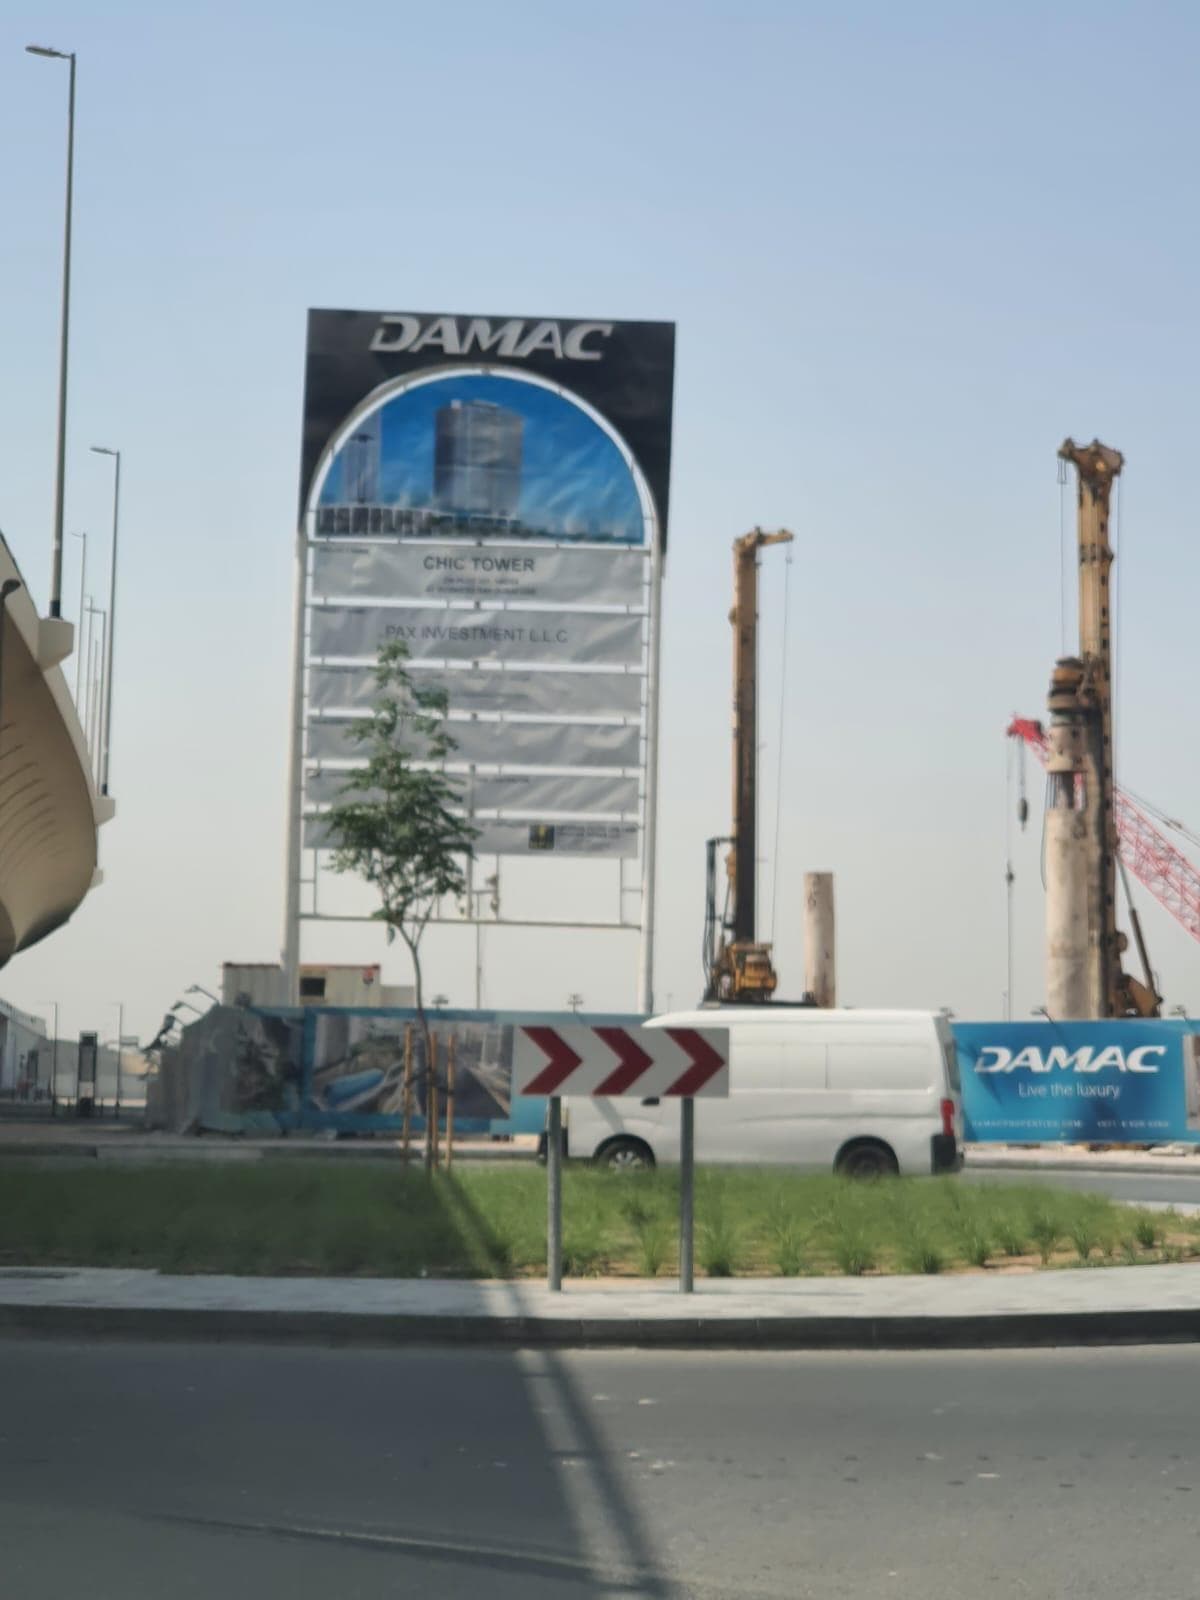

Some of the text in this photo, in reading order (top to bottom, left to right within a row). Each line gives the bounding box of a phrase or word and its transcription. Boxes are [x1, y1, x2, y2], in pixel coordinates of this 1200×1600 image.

[368, 315, 613, 361] DAMAC
[423, 555, 535, 572] CHIC TOWER
[385, 625, 416, 639] PAX
[421, 626, 524, 642] INVESTMENT
[974, 1045, 1167, 1073] DAMAC
[1018, 1083, 1120, 1099] Live the luxury
